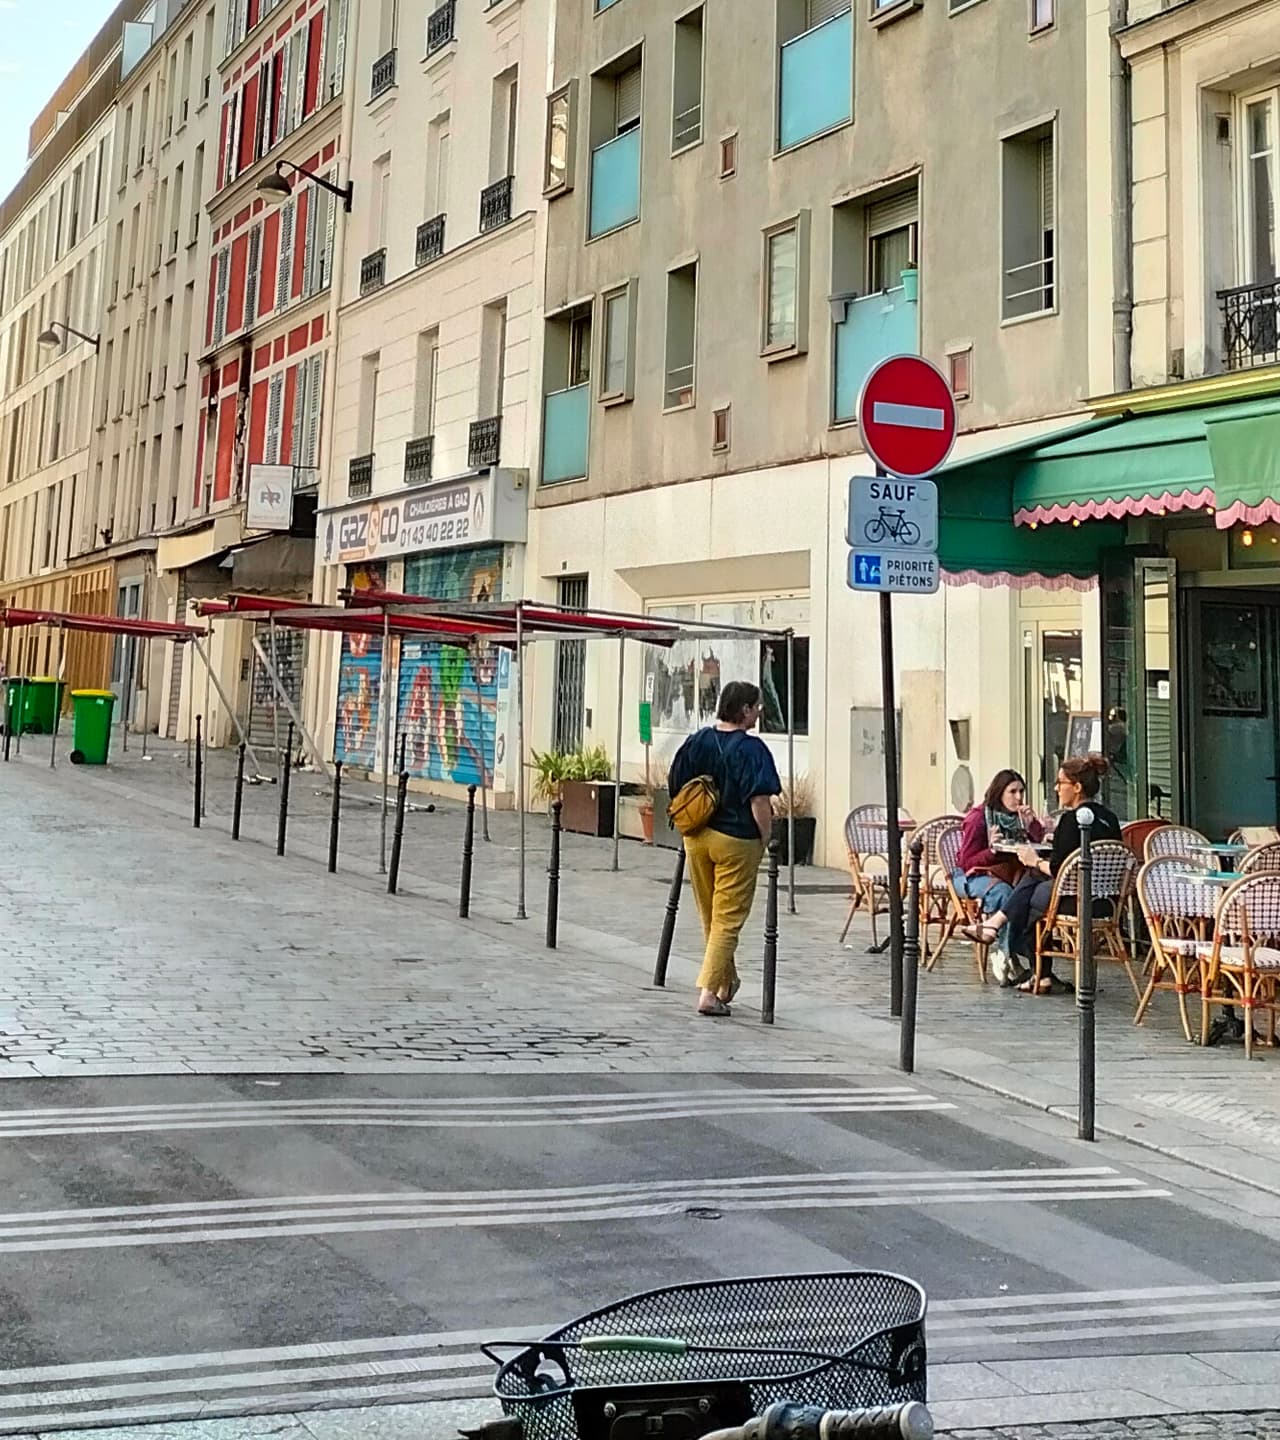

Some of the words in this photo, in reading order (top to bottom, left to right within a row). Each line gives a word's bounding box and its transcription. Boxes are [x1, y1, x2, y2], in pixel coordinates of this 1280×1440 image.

[454, 491, 469, 508] GAZ
[869, 482, 917, 502] SAUF
[412, 524, 424, 546] 43
[426, 522, 439, 543] 40
[440, 520, 454, 540] 22
[456, 517, 469, 539] 22
[887, 559, 935, 573] PRIORITÉ
[888, 573, 933, 587] PIÉTONS
